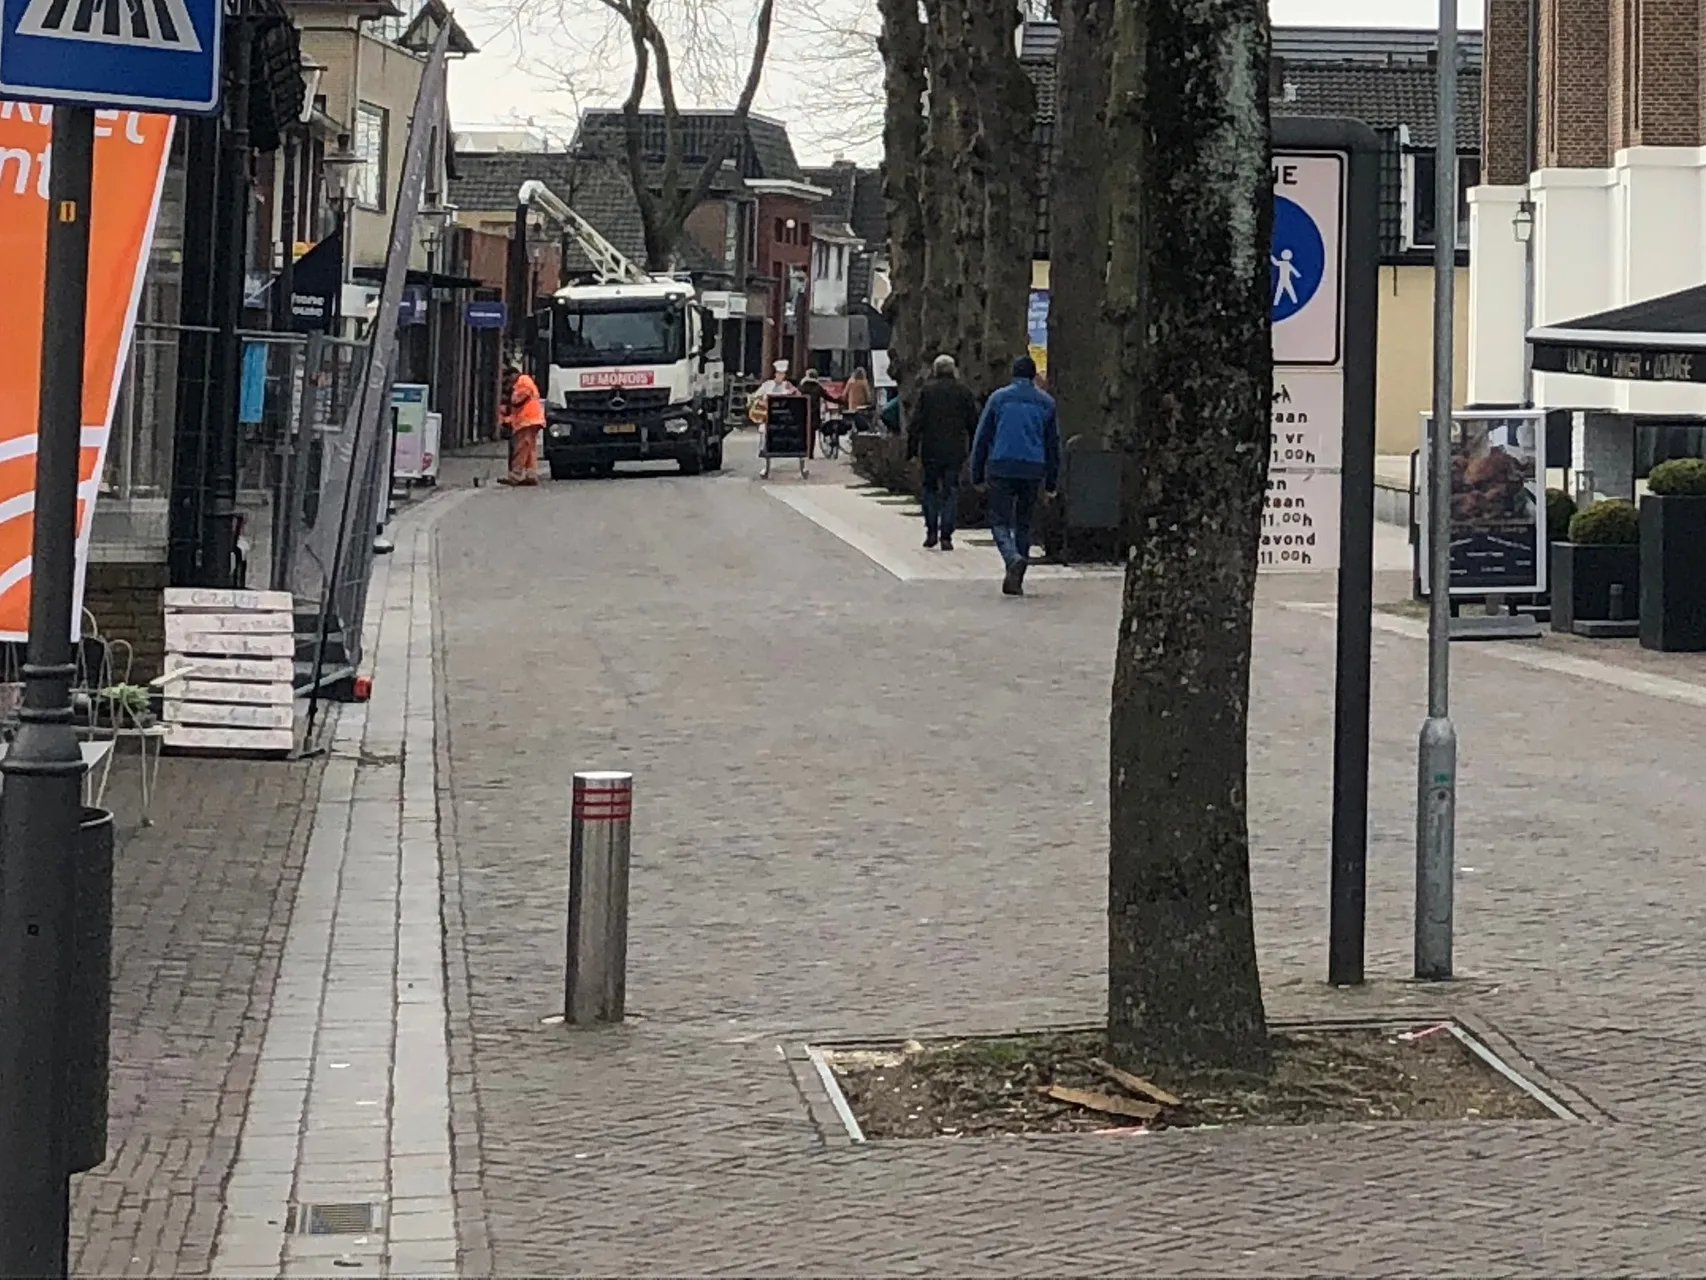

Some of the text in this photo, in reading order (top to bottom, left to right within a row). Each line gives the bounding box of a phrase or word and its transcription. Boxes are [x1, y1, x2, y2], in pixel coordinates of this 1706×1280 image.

[1285, 433, 1305, 444] vr
[1273, 449, 1316, 463] 1.00h
[1261, 532, 1316, 546] avond
